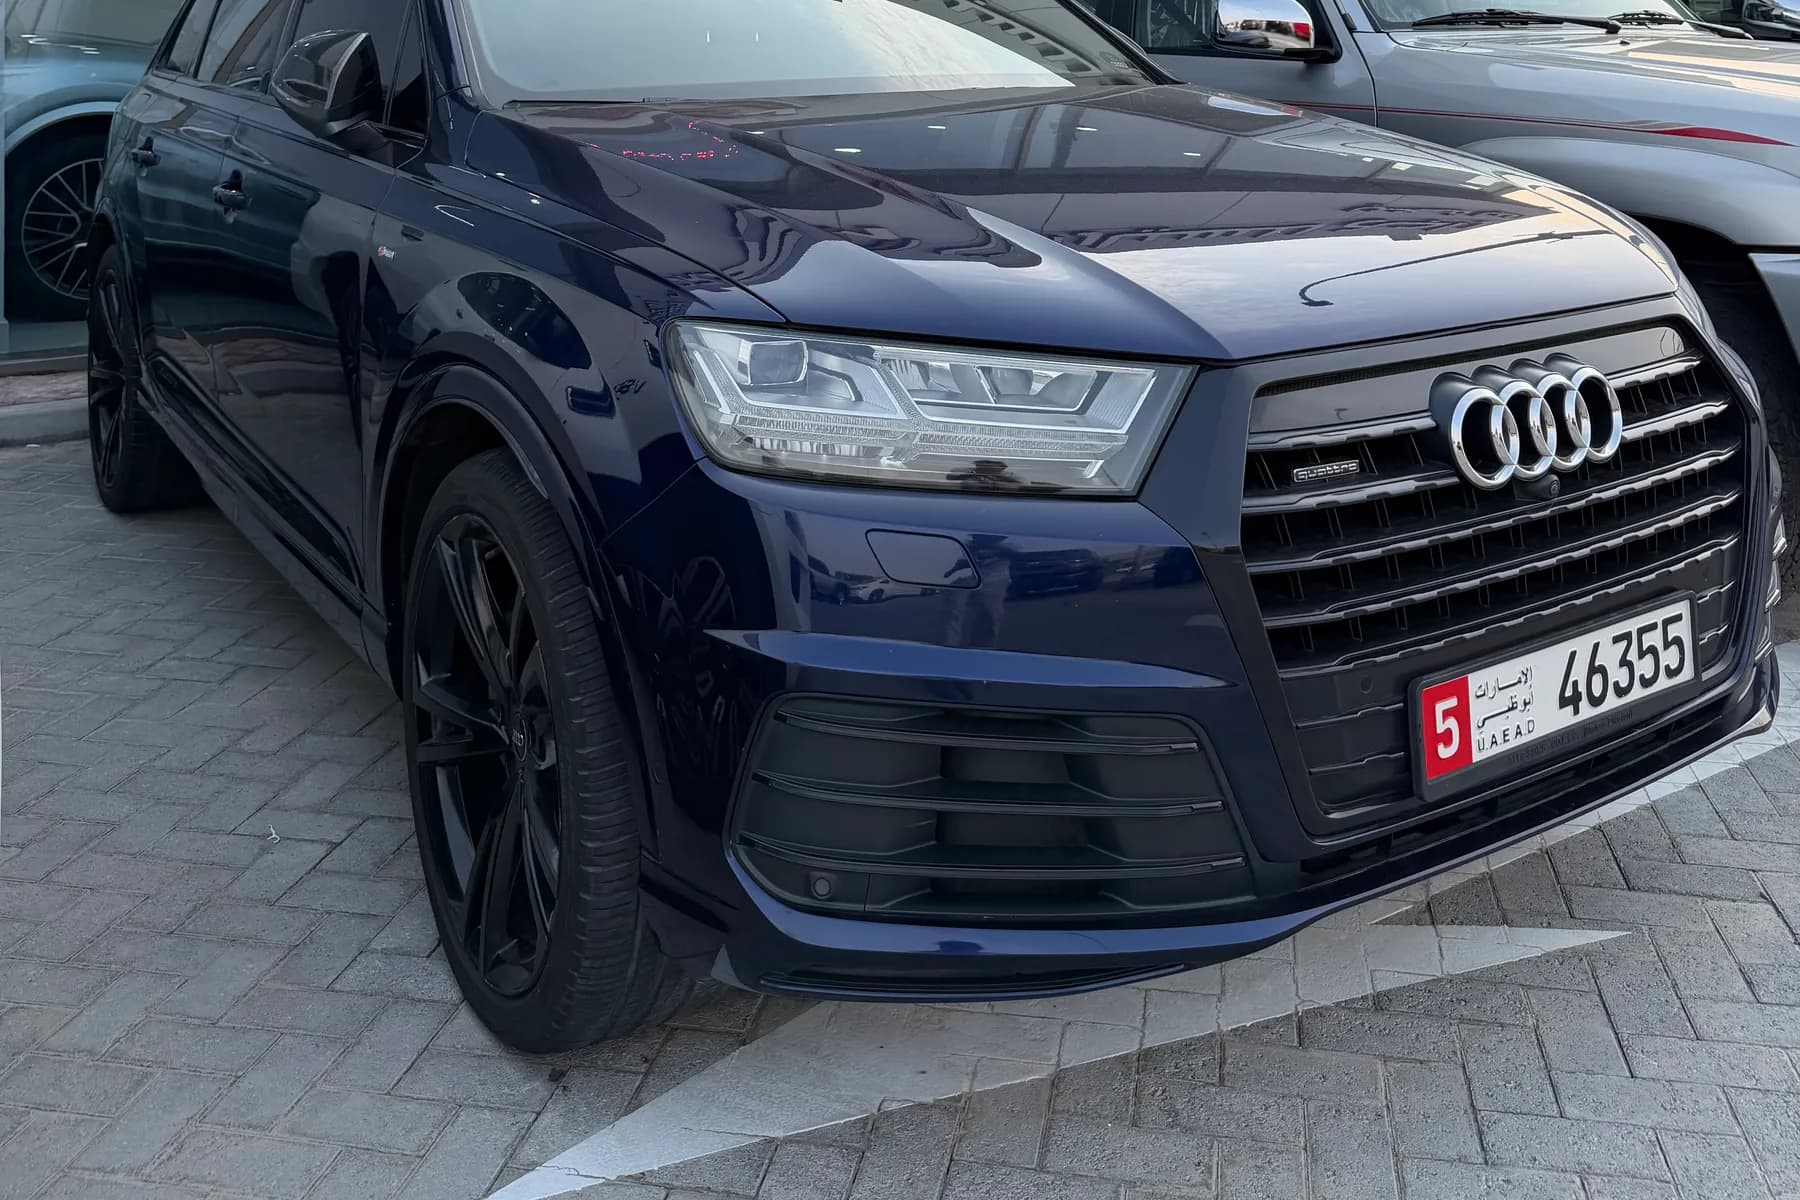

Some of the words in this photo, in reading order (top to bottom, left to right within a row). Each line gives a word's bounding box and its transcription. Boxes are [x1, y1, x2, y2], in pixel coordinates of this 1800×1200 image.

[1297, 462, 1357, 481] quattro
[1557, 612, 1686, 716] 46355
[1434, 696, 1460, 759] 5
